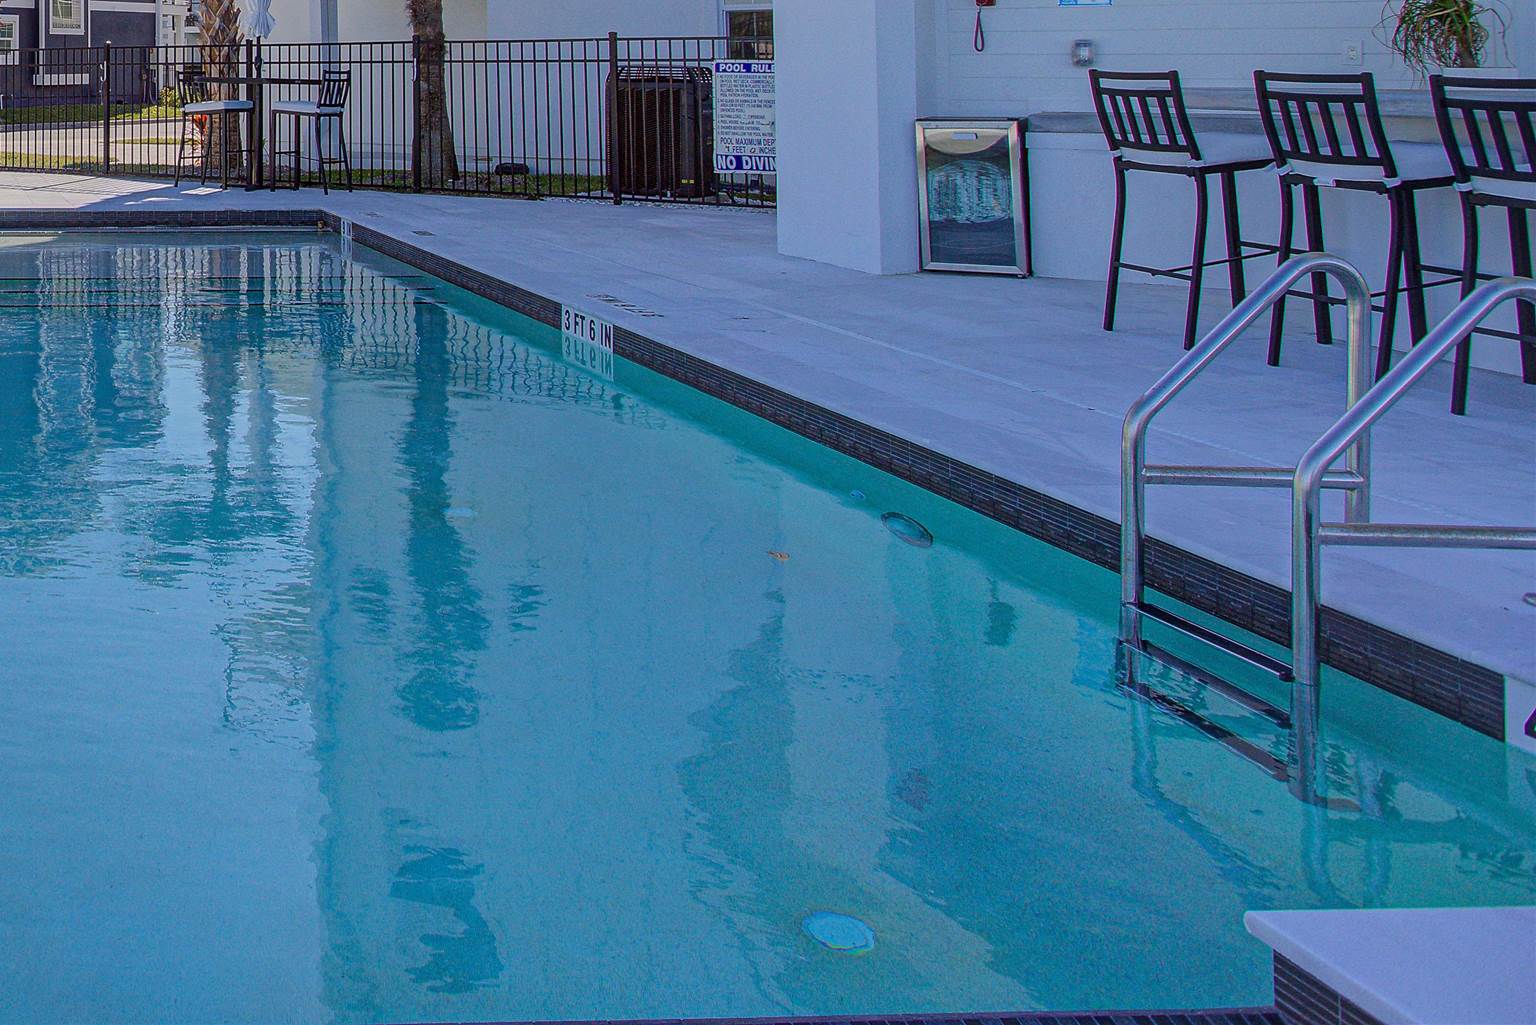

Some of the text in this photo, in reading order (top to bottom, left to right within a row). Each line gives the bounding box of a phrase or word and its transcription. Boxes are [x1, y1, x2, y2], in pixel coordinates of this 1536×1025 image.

[719, 63, 775, 73] POOL RULE
[720, 137, 734, 145] POOL
[736, 137, 762, 146] MAXIMUM
[732, 146, 746, 154] FEET
[759, 146, 776, 155] INCHE
[717, 155, 736, 170] NO
[564, 309, 611, 349] 3 FT 6 IN
